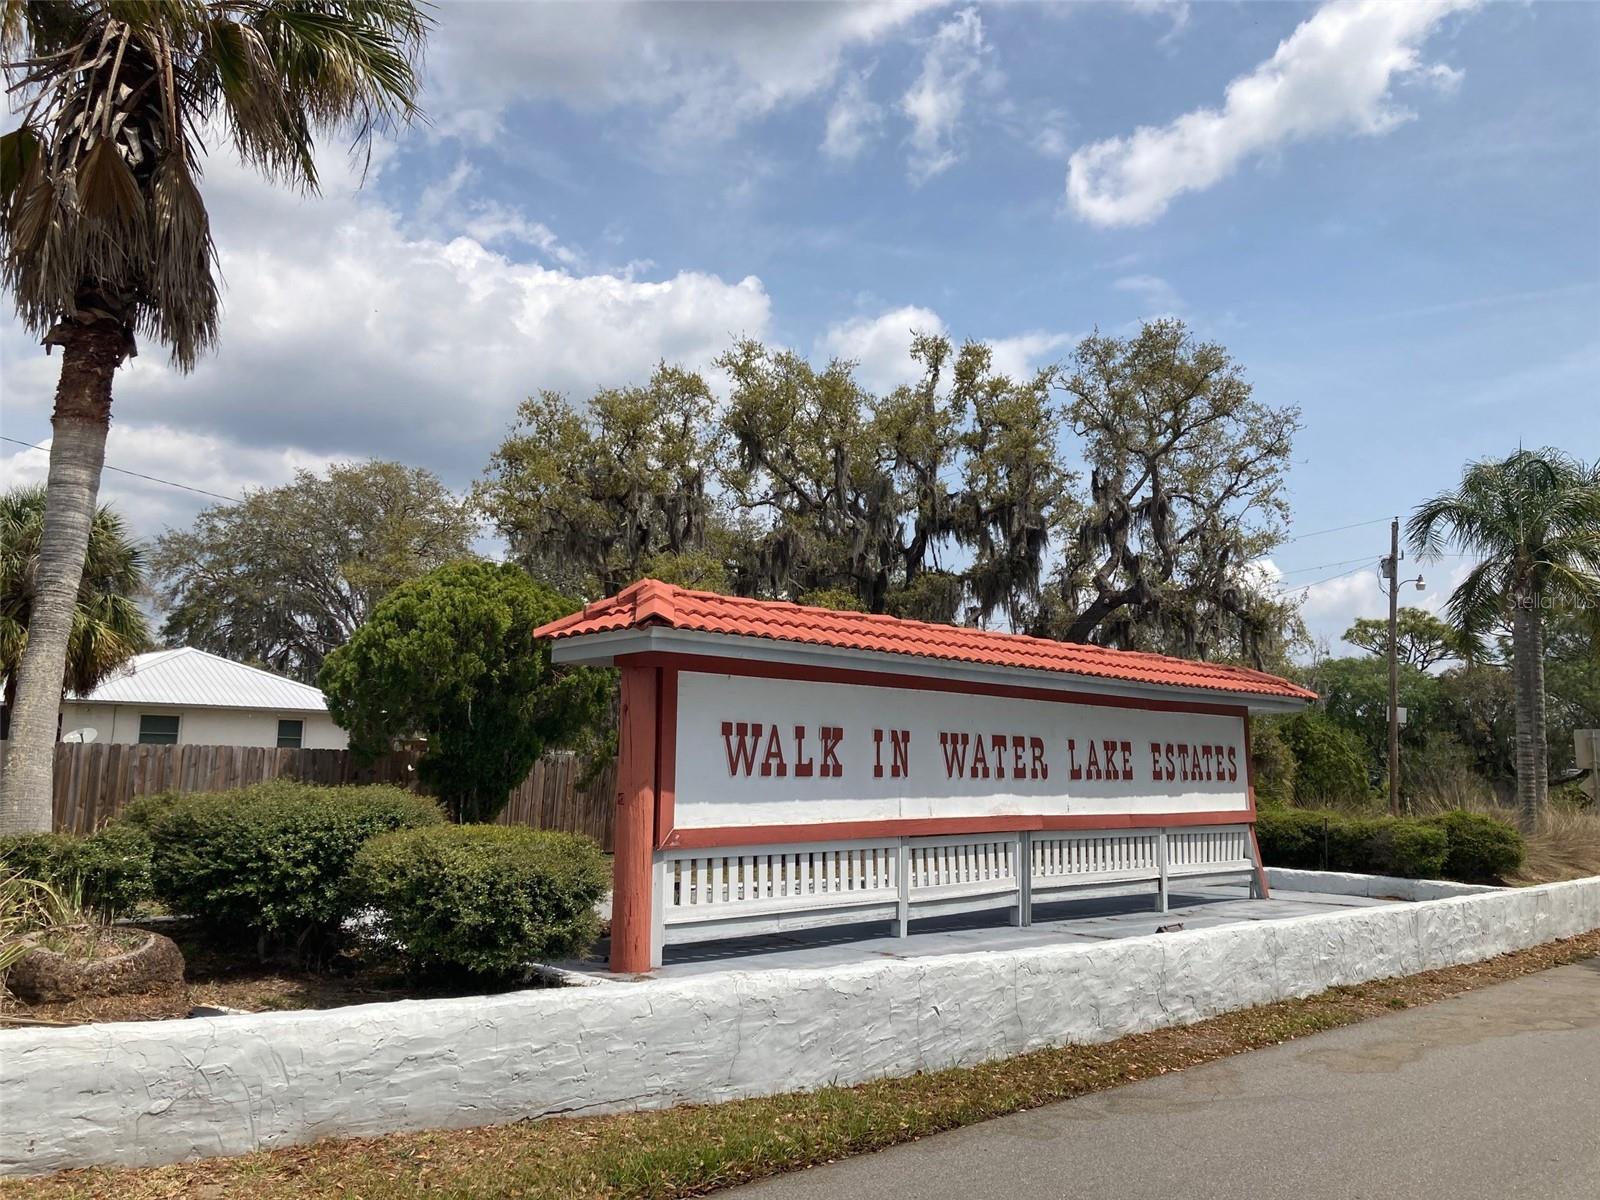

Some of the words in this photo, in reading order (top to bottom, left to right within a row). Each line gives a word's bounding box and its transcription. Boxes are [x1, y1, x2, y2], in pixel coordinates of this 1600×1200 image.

[721, 721, 844, 777] WALK
[873, 729, 910, 778] IN
[940, 732, 1048, 780] WATER
[1068, 739, 1133, 781] LAKE
[1151, 743, 1237, 783] ESTATES
